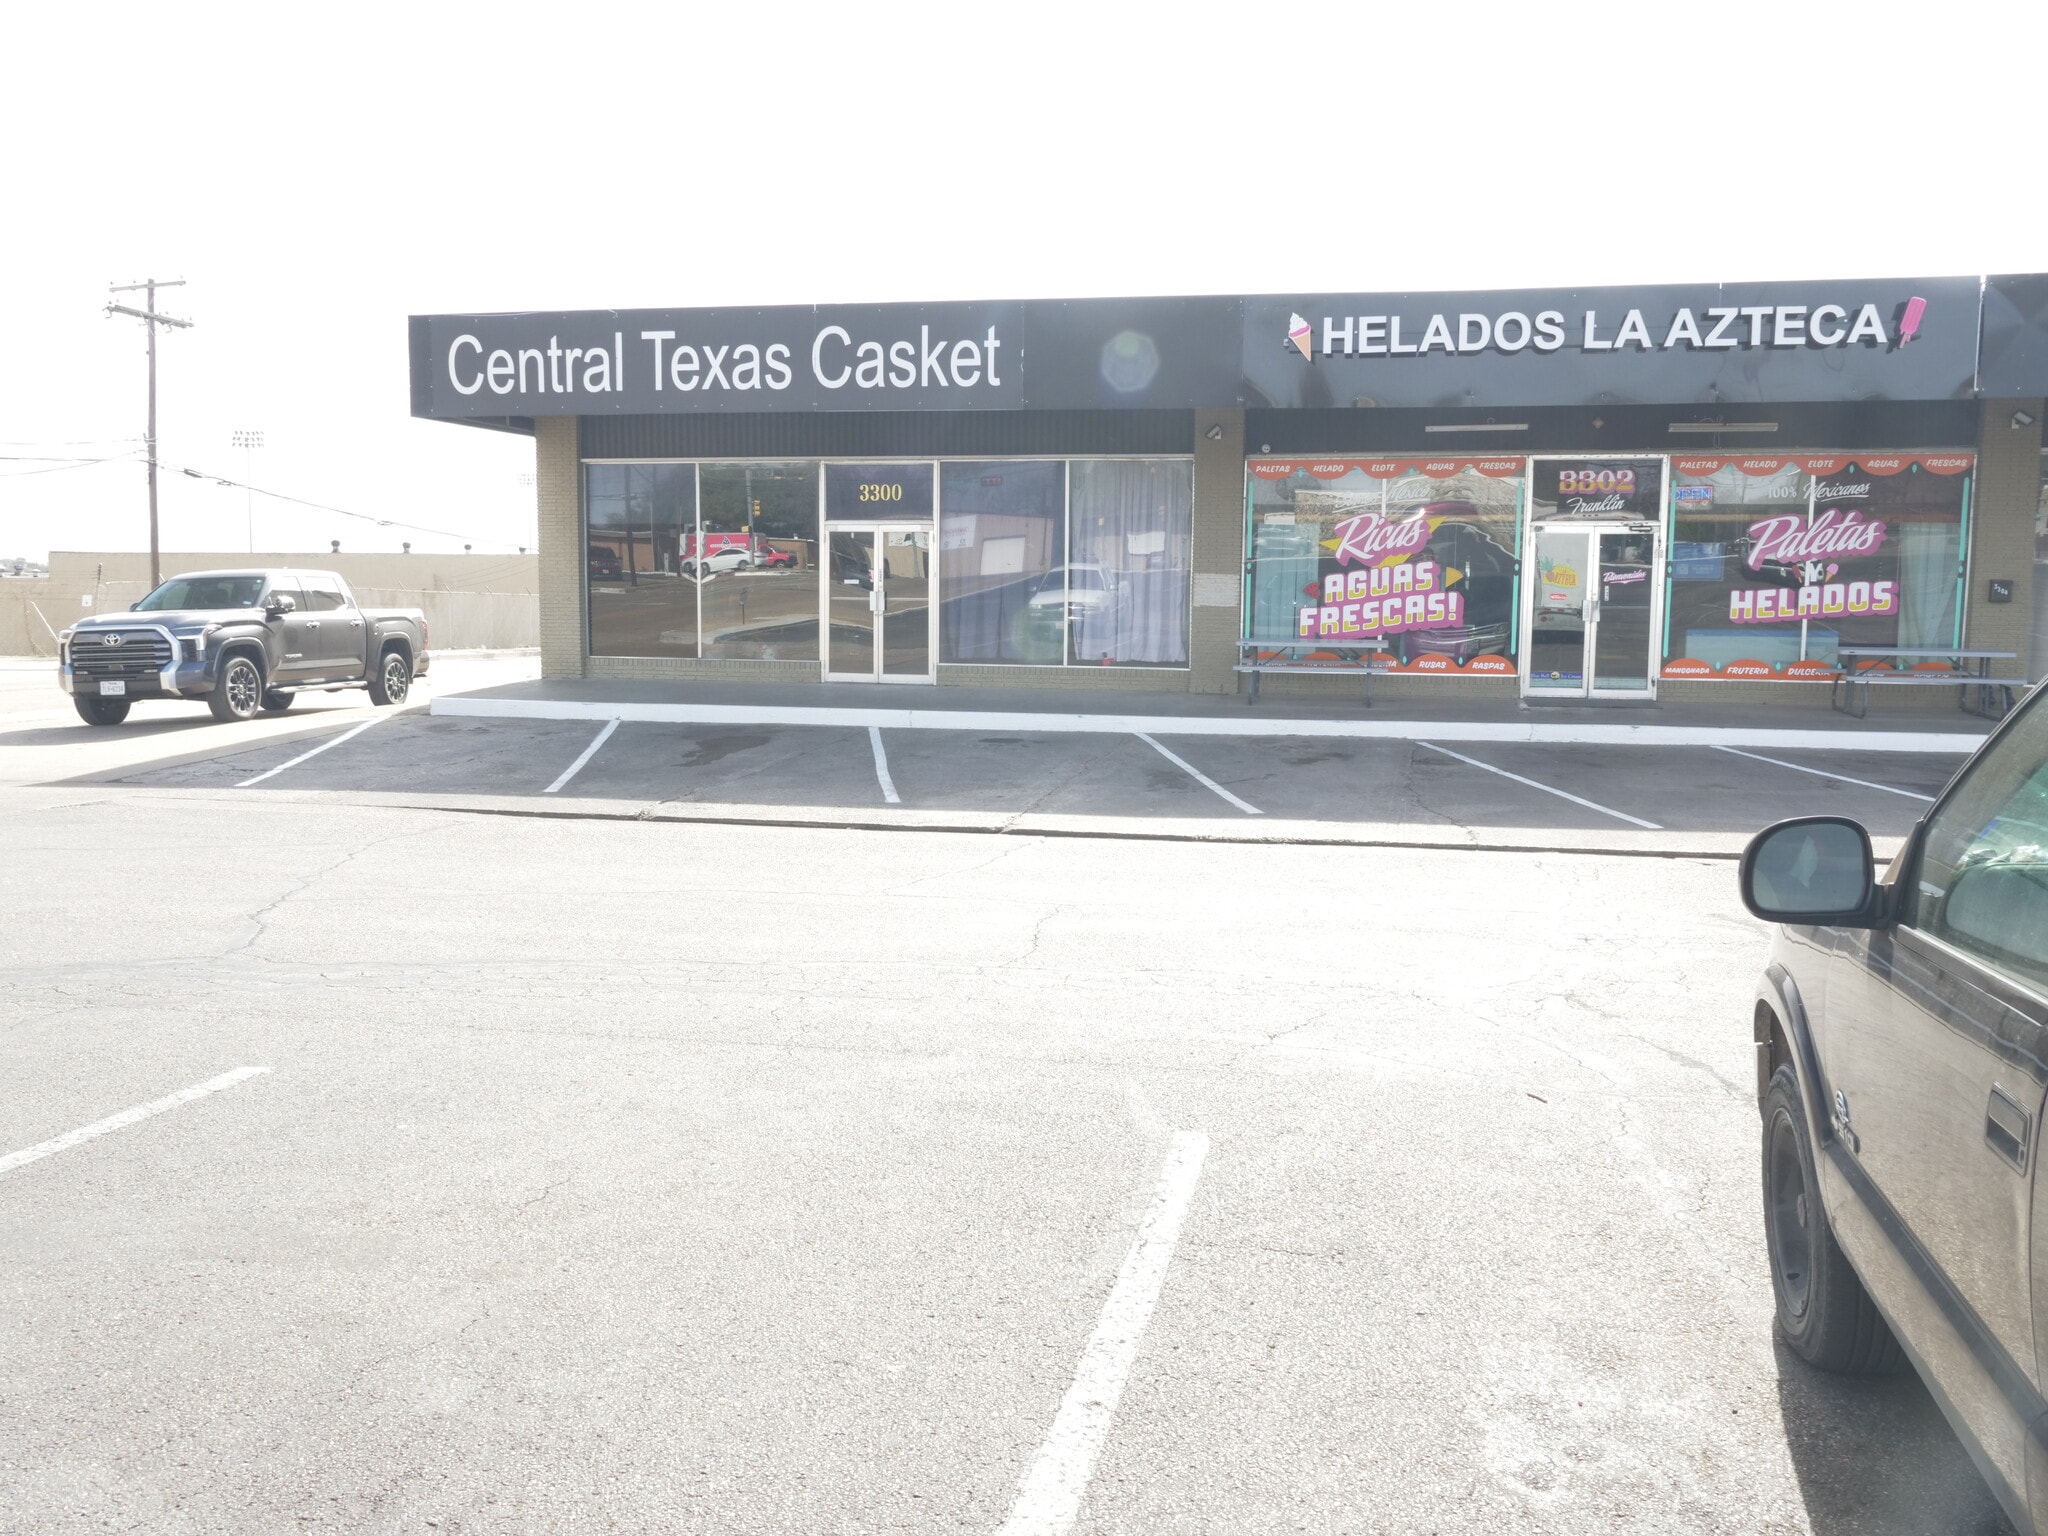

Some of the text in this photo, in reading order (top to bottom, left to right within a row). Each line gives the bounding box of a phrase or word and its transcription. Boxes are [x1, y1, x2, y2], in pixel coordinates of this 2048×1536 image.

[1322, 303, 1888, 355] HELADOS LA AZTECA
[447, 324, 1001, 395] Central Texas Casket
[1255, 461, 1517, 473] PALETAS HELADO ELOTE AGUAS FRESCAS
[1679, 458, 1968, 469] PALETAS HELADO ELOTE AGUAS FRESCAS
[859, 484, 902, 502] 3300
[1559, 470, 1635, 493] 3302
[1768, 482, 1871, 502] 100% Mexicanos
[1566, 494, 1626, 515] Franklin
[1335, 513, 1425, 560] Ricas
[1748, 510, 1881, 567] Paletas
[1325, 561, 1434, 603] AGUAS
[1730, 581, 1893, 619] HELADOS
[1299, 592, 1458, 636] FRESCAS!
[1418, 660, 1506, 670] RUSAS RASPAS
[1664, 666, 1710, 675] MANGONADA
[1726, 666, 1769, 675] FRUTERIA
